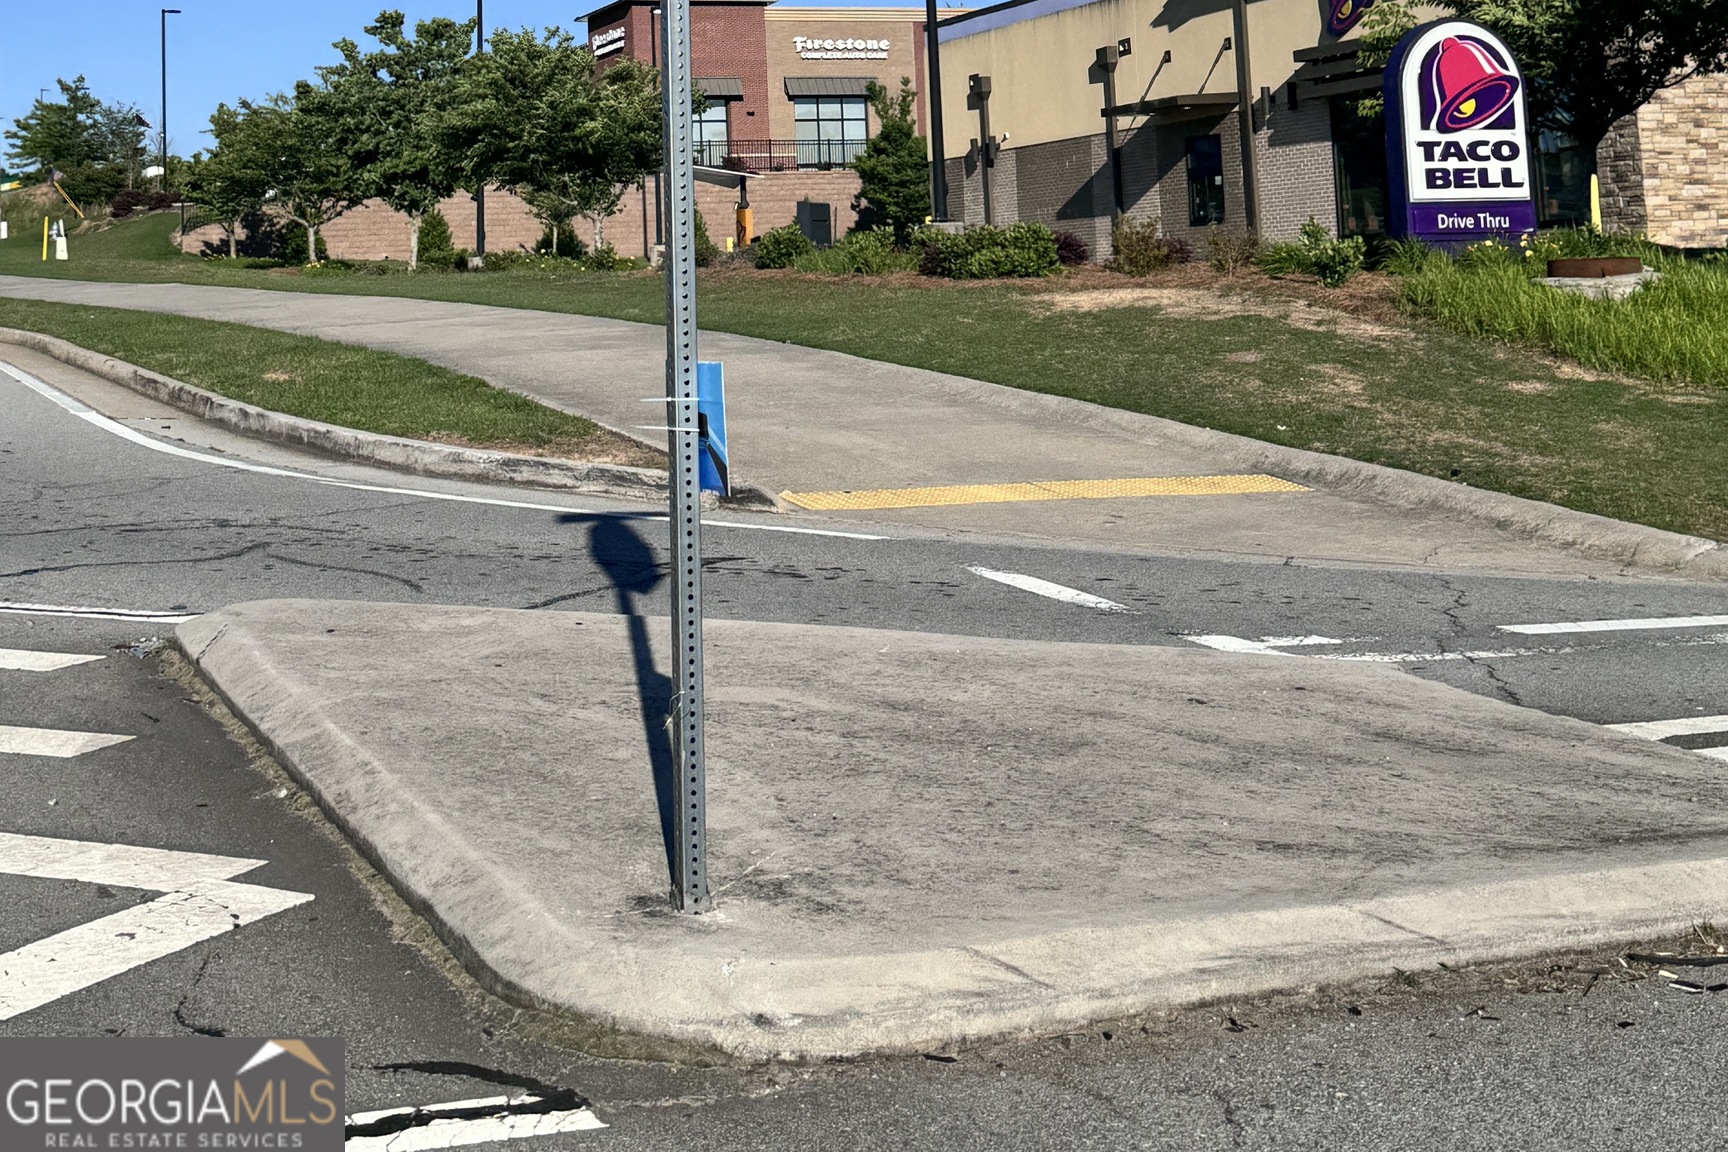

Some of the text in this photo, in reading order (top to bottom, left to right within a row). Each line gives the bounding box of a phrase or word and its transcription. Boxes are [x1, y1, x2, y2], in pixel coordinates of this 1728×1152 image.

[793, 36, 891, 52] Firestone
[1416, 140, 1520, 162] TACO
[1425, 167, 1525, 189] BELL
[1437, 212, 1510, 229] Drive Thru
